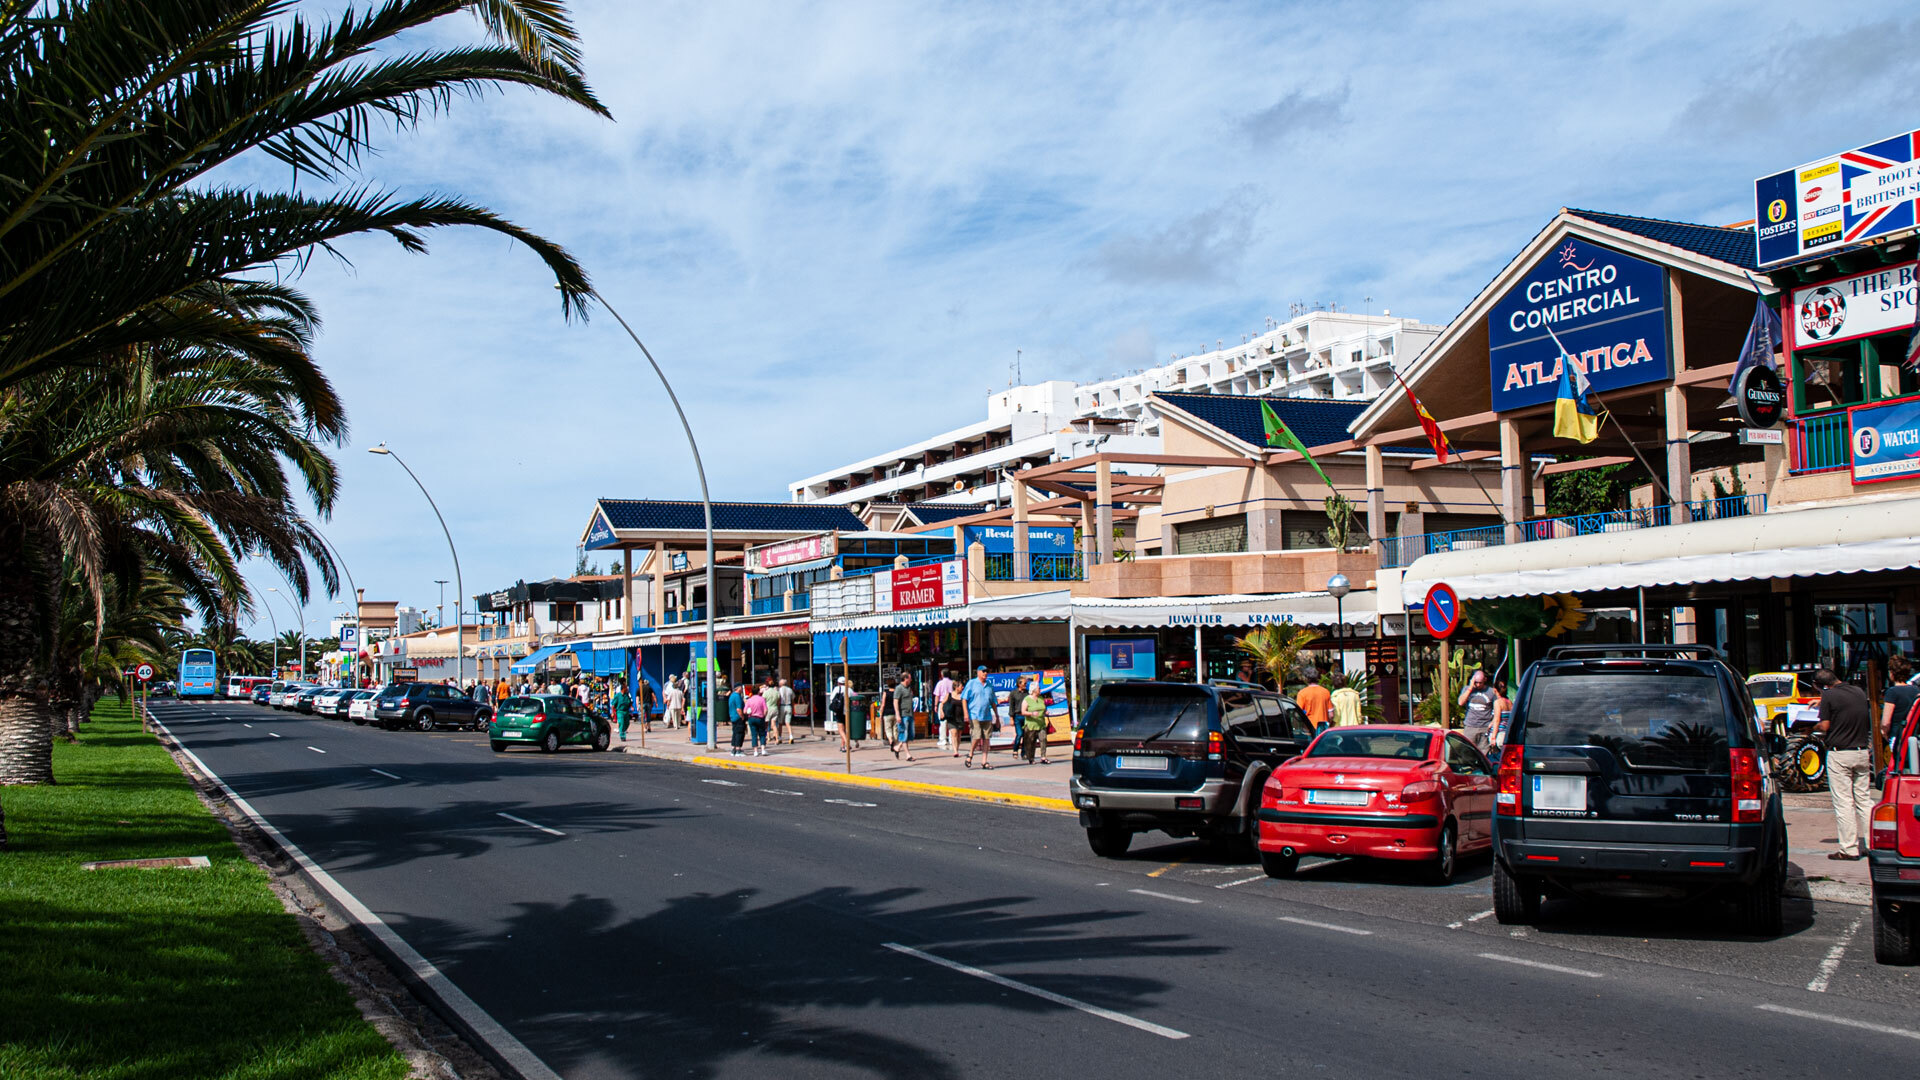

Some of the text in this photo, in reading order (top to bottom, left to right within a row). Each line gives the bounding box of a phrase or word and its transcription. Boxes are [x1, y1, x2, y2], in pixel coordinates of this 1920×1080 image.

[1878, 167, 1913, 186] BOOT
[1856, 186, 1905, 209] BRITISH
[1817, 205, 1839, 216] SPORTS
[1809, 234, 1837, 246] SPORTS
[1526, 264, 1617, 303] CENTRO
[1848, 271, 1892, 297] THE
[1509, 285, 1640, 332] COMERCIAL
[1803, 295, 1843, 320] SKY
[1804, 315, 1844, 331] SPORTS
[1503, 338, 1654, 392] ATLANTICA
[1747, 388, 1780, 402] GUINNESS
[1882, 428, 1919, 448] WATCH
[590, 529, 609, 543] SHOPPING
[899, 588, 936, 606] KRAMER
[1168, 614, 1294, 625] JUWELIER KRAMER
[345, 629, 355, 640] P
[411, 658, 444, 667] ESPRIT
[139, 668, 152, 676] 40
[1532, 810, 1588, 818] DISCOVERY
